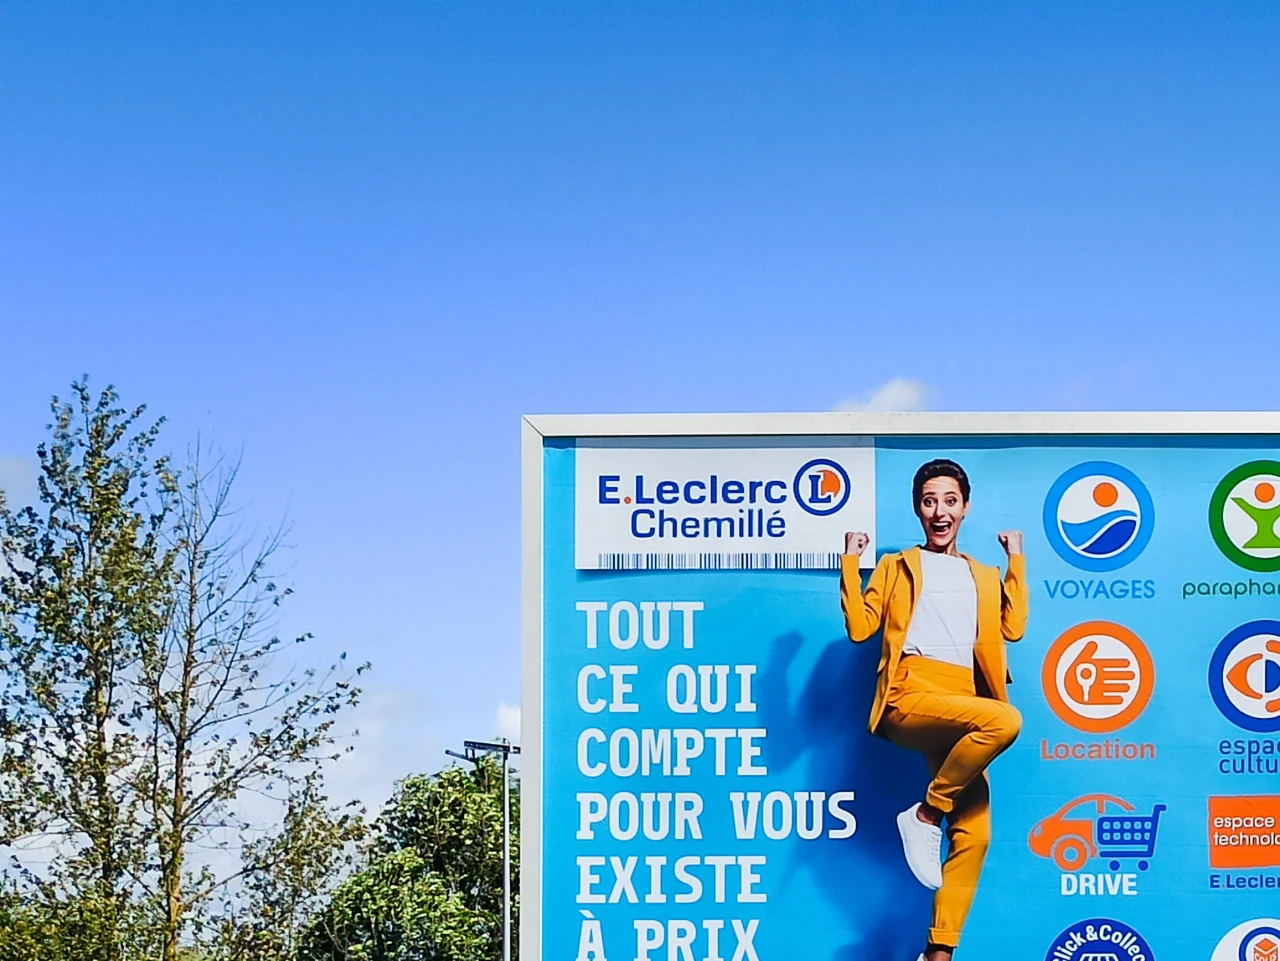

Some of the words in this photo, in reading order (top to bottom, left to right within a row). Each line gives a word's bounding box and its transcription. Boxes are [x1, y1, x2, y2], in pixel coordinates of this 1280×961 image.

[598, 474, 788, 505] E.Leclerc
[631, 508, 786, 539] Chemillé
[1044, 579, 1156, 600] VOYAGES
[576, 601, 705, 649] TOUT
[577, 664, 640, 713] CE
[666, 664, 757, 714] QUI
[577, 728, 768, 776] COMPTE
[1041, 738, 1156, 760] Location
[576, 792, 705, 840] POUR
[730, 791, 857, 840] VOUS
[1213, 816, 1275, 831] espace
[576, 856, 768, 904] EXISTE
[1061, 874, 1138, 896] DRIVE
